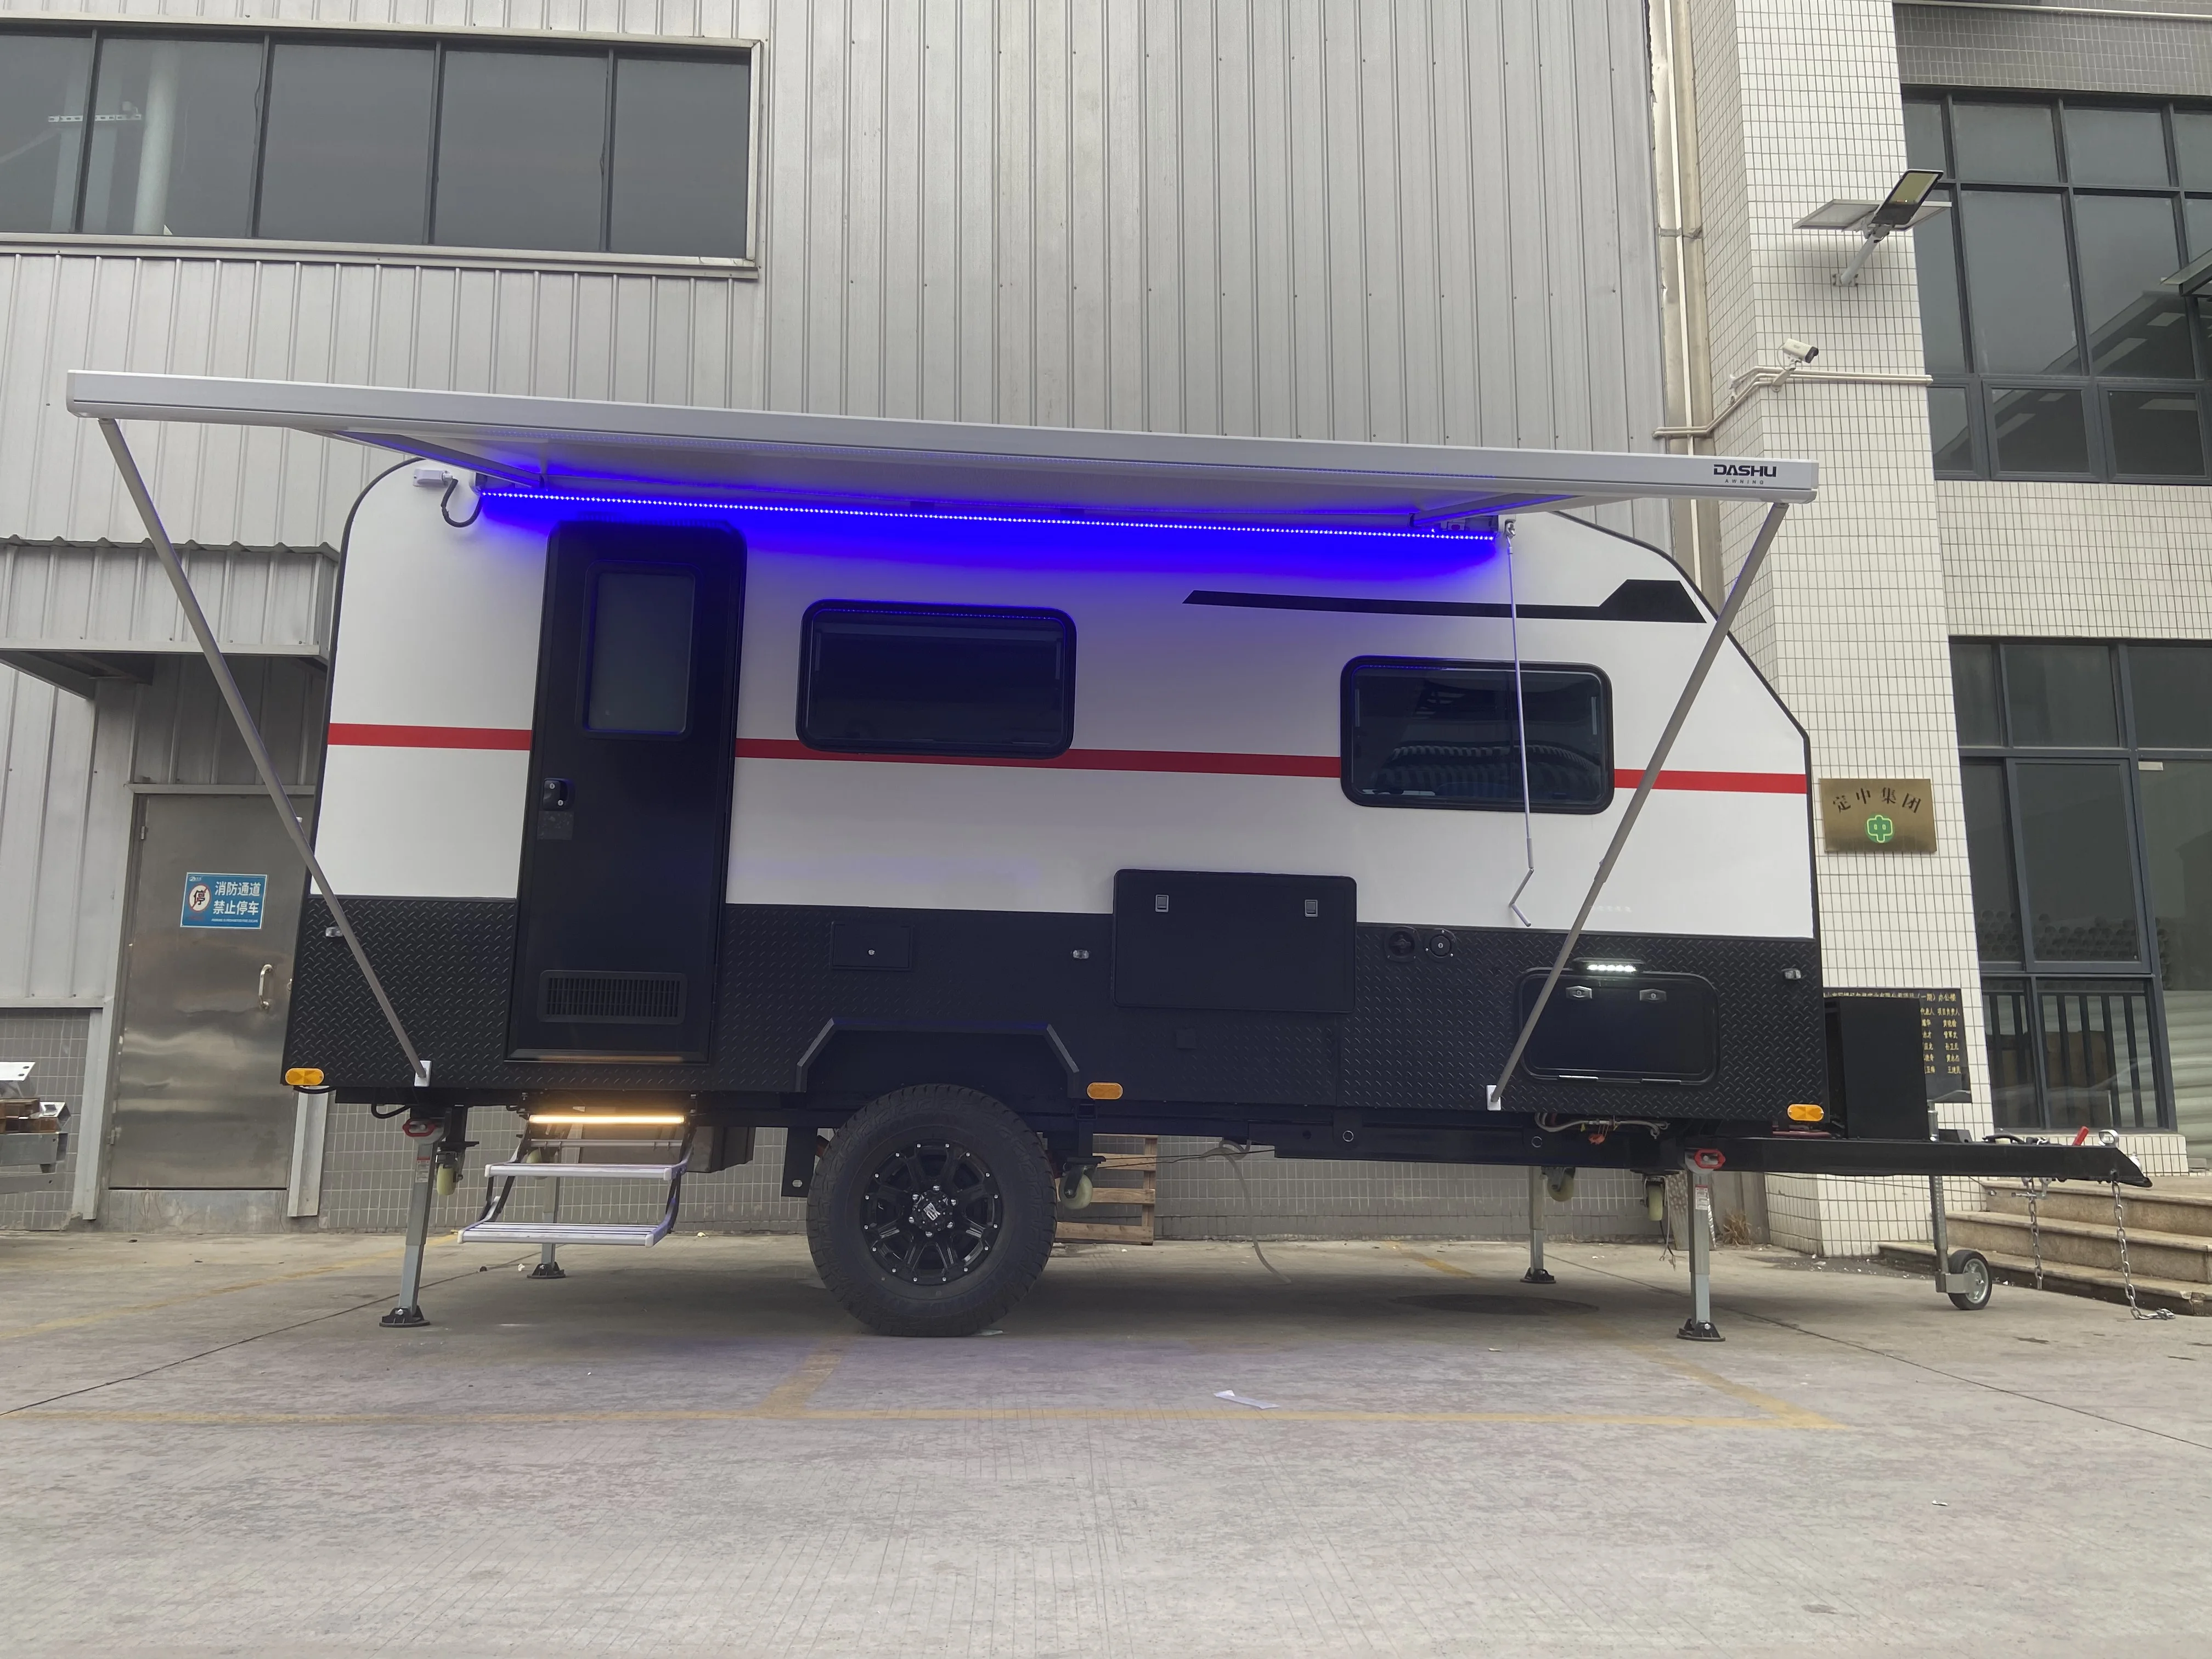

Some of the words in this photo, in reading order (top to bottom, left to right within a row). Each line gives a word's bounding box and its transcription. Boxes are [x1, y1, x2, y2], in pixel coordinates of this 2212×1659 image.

[1713, 464, 1776, 477] DASHU
[215, 881, 261, 896] 消防通道
[213, 900, 259, 915] 禁止停车
